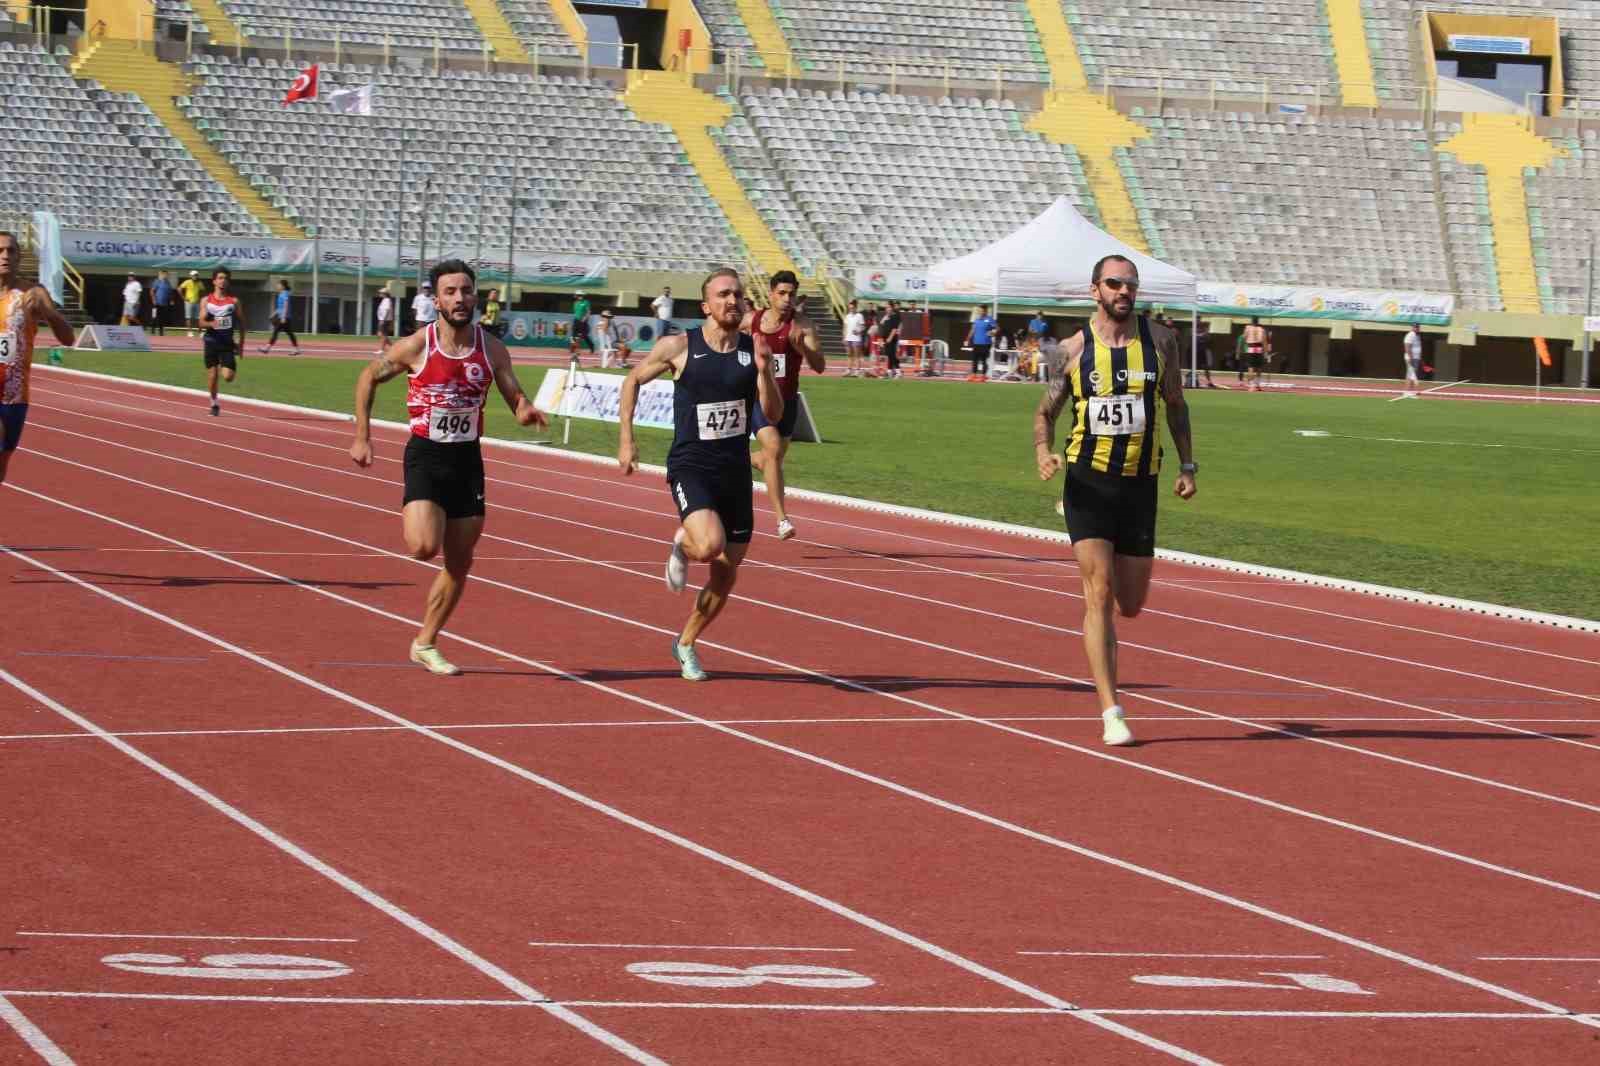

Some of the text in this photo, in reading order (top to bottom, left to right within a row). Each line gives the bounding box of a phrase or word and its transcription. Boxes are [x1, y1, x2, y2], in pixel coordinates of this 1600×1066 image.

[96, 240, 150, 257] GENÇLİK
[151, 244, 166, 256] VE
[168, 245, 201, 257] SPOR
[205, 246, 272, 260] BAKANLIĞI
[905, 277, 927, 289] TÜR
[0, 340, 9, 356] 3
[706, 408, 740, 431] 472
[1097, 402, 1134, 426] 451
[436, 415, 471, 434] 496
